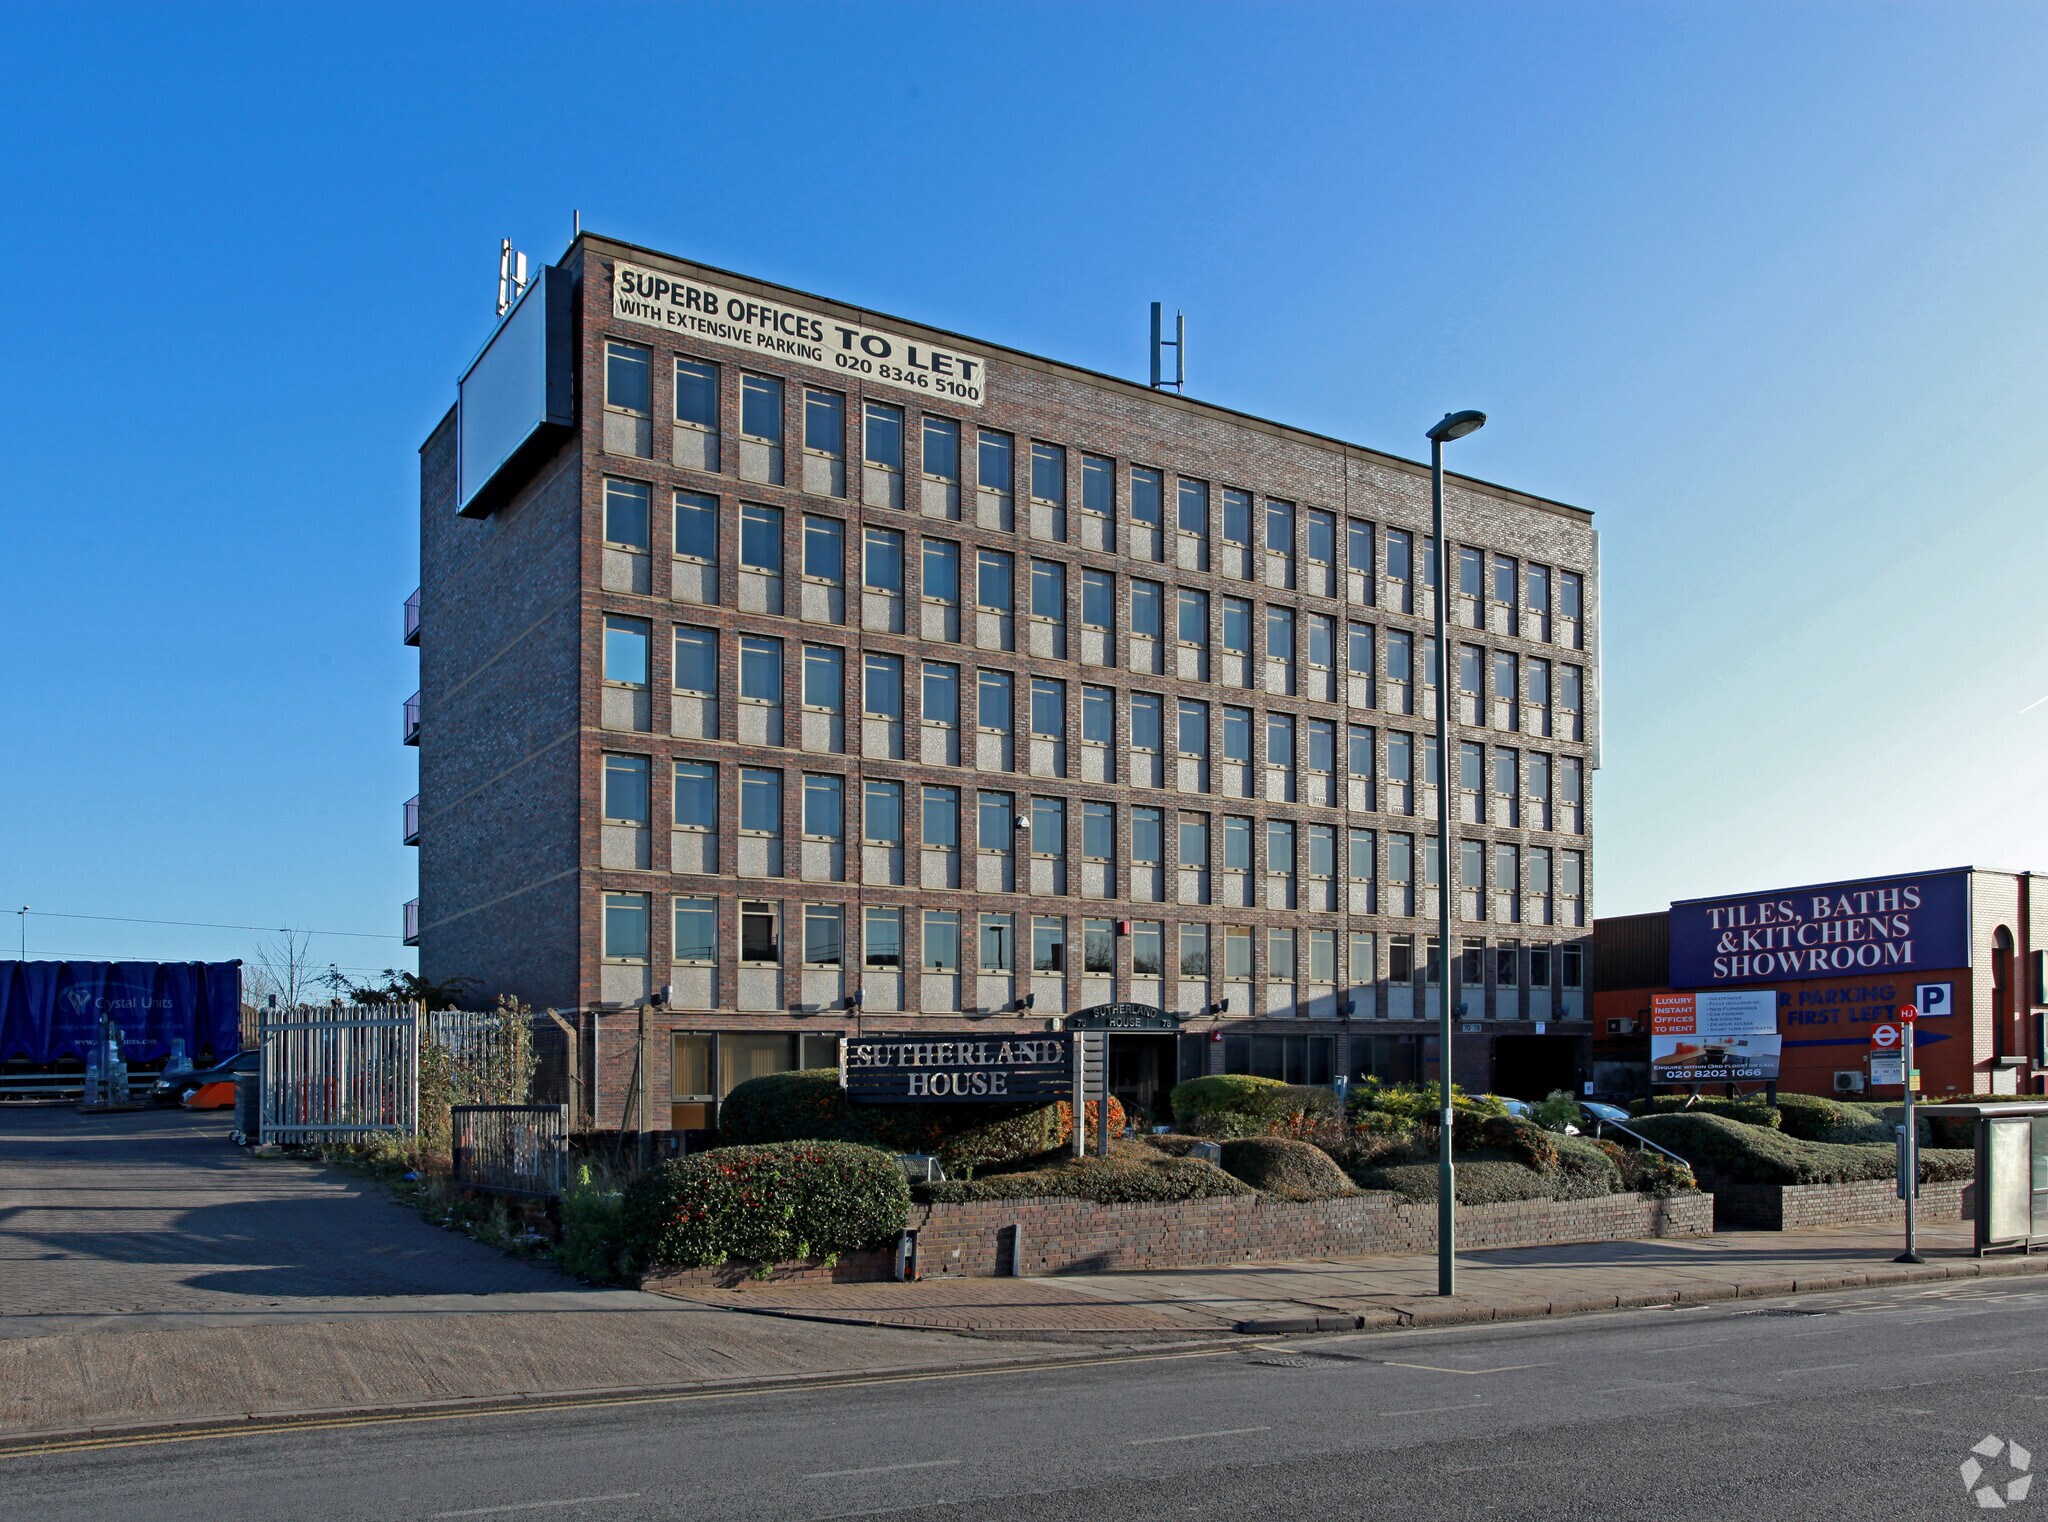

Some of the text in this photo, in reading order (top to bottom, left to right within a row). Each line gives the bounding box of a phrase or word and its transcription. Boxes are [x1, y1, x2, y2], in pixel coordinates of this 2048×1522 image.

[620, 270, 824, 342] SUPERB OFFICES
[620, 298, 822, 362] WITH EXTENSIVE PARKING
[834, 326, 978, 381] TO LET
[835, 353, 979, 401] 020 8346 5100
[1706, 886, 1921, 930] TILES, BATHS
[1713, 940, 1915, 978] SHOWROOM
[95, 998, 173, 1011] Crystal Units
[1798, 984, 1896, 1006] PARKING
[1922, 986, 1944, 1014] P
[1093, 1004, 1158, 1018] SUTHERLAND
[1110, 1018, 1141, 1027] HOUSE
[1788, 1005, 1896, 1026] FIRST LEFT
[1902, 1010, 1913, 1018] HJ
[856, 1040, 1063, 1068] SUTHERLAND
[907, 1072, 1008, 1096] HOUSE
[1666, 1070, 1691, 1078] 020
[1694, 1070, 1727, 1078] 8202
